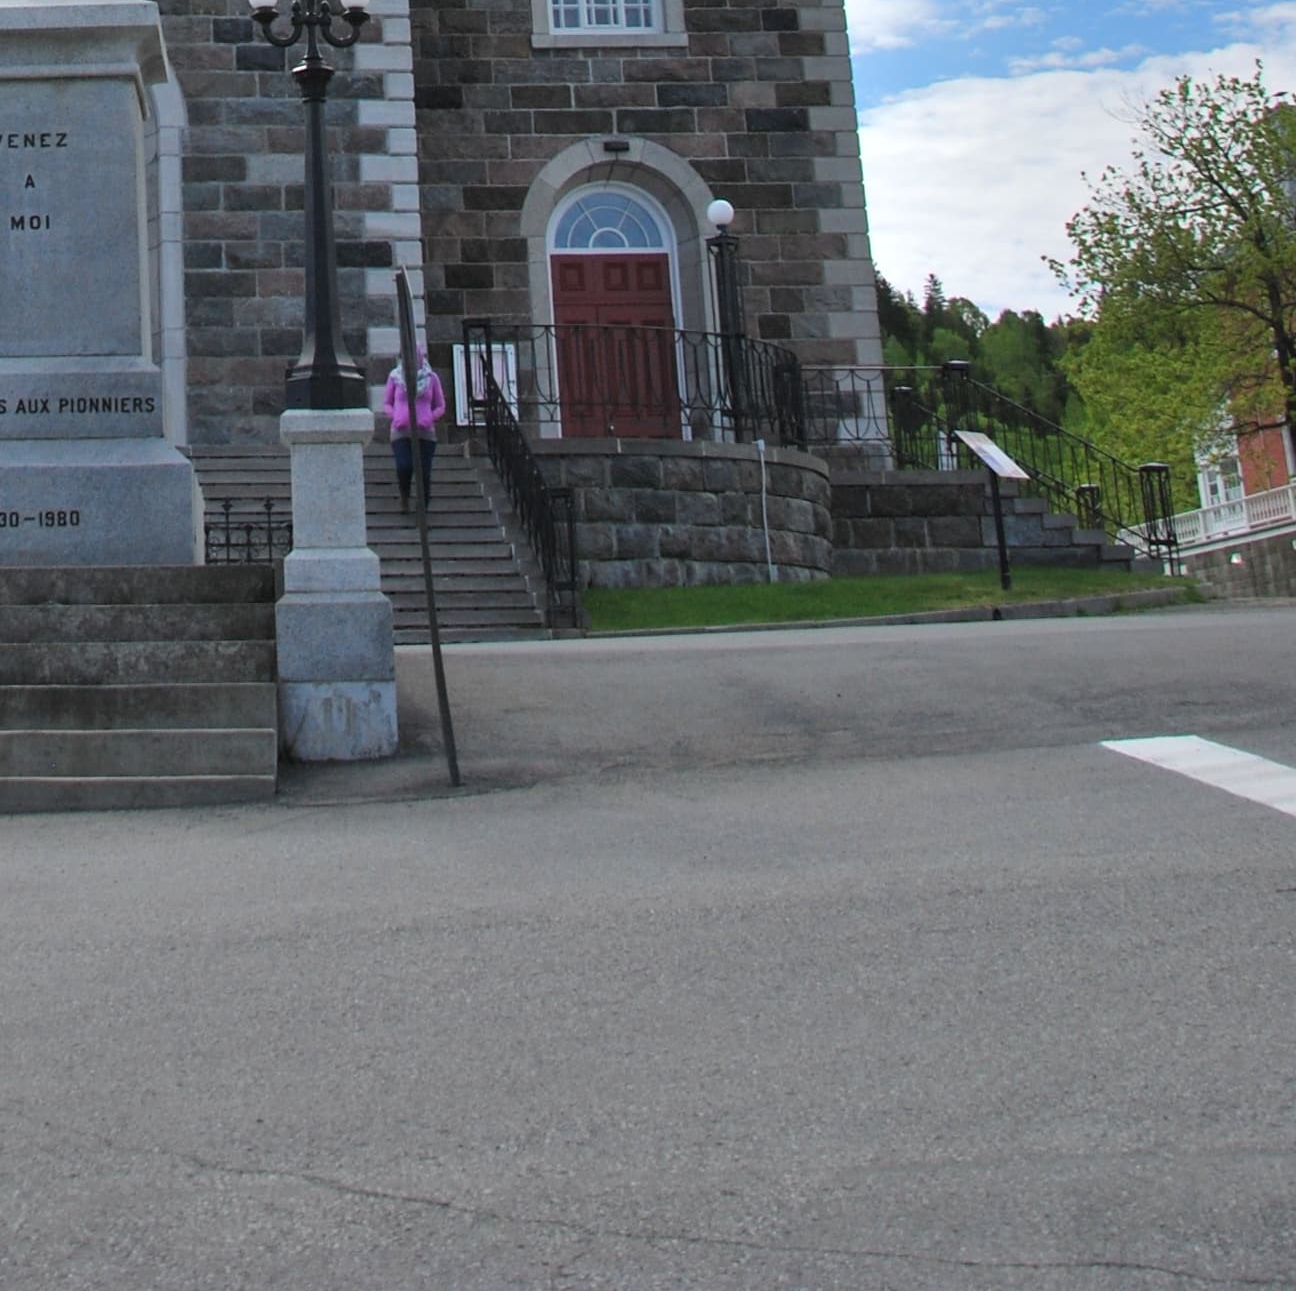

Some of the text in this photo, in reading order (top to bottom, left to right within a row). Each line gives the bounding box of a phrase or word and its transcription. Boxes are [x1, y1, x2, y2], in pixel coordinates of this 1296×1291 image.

[24, 173, 36, 189] A
[10, 215, 51, 231] MOI
[15, 397, 51, 414] AUX
[58, 397, 156, 414] PIONNIERS
